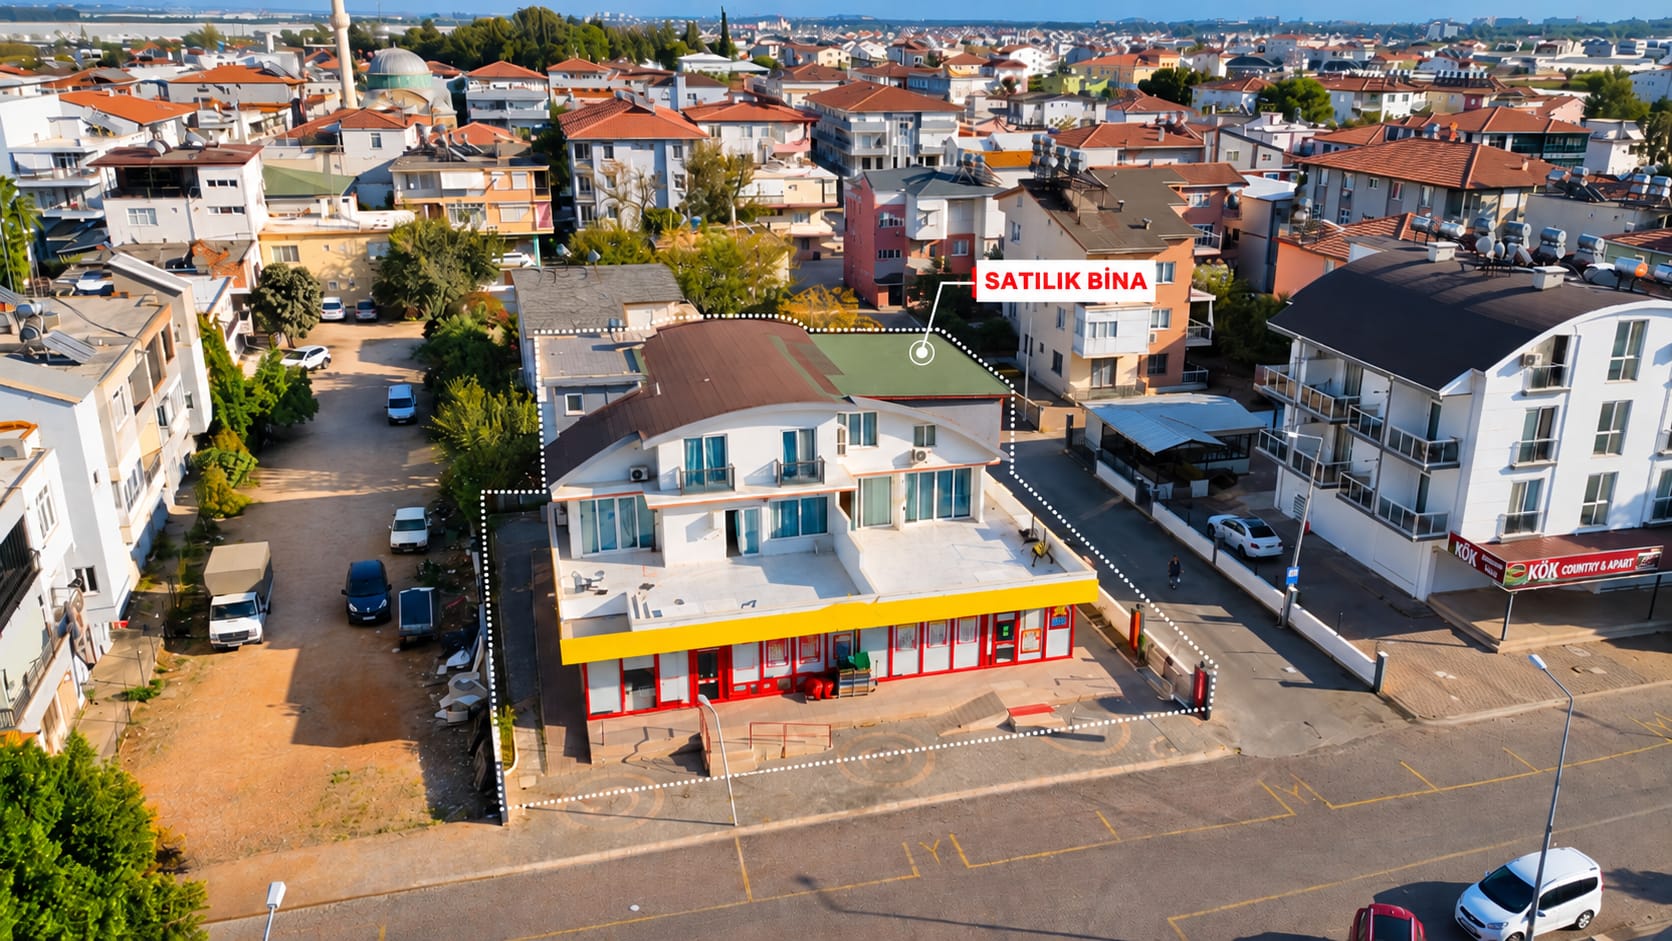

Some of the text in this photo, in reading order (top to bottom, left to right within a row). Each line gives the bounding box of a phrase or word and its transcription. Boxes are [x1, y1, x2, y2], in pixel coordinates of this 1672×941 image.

[1455, 541, 1477, 568] KÖK
[1527, 559, 1560, 581] KÖK
[1561, 560, 1600, 575] COUNTRY
[1607, 557, 1635, 570] APART
